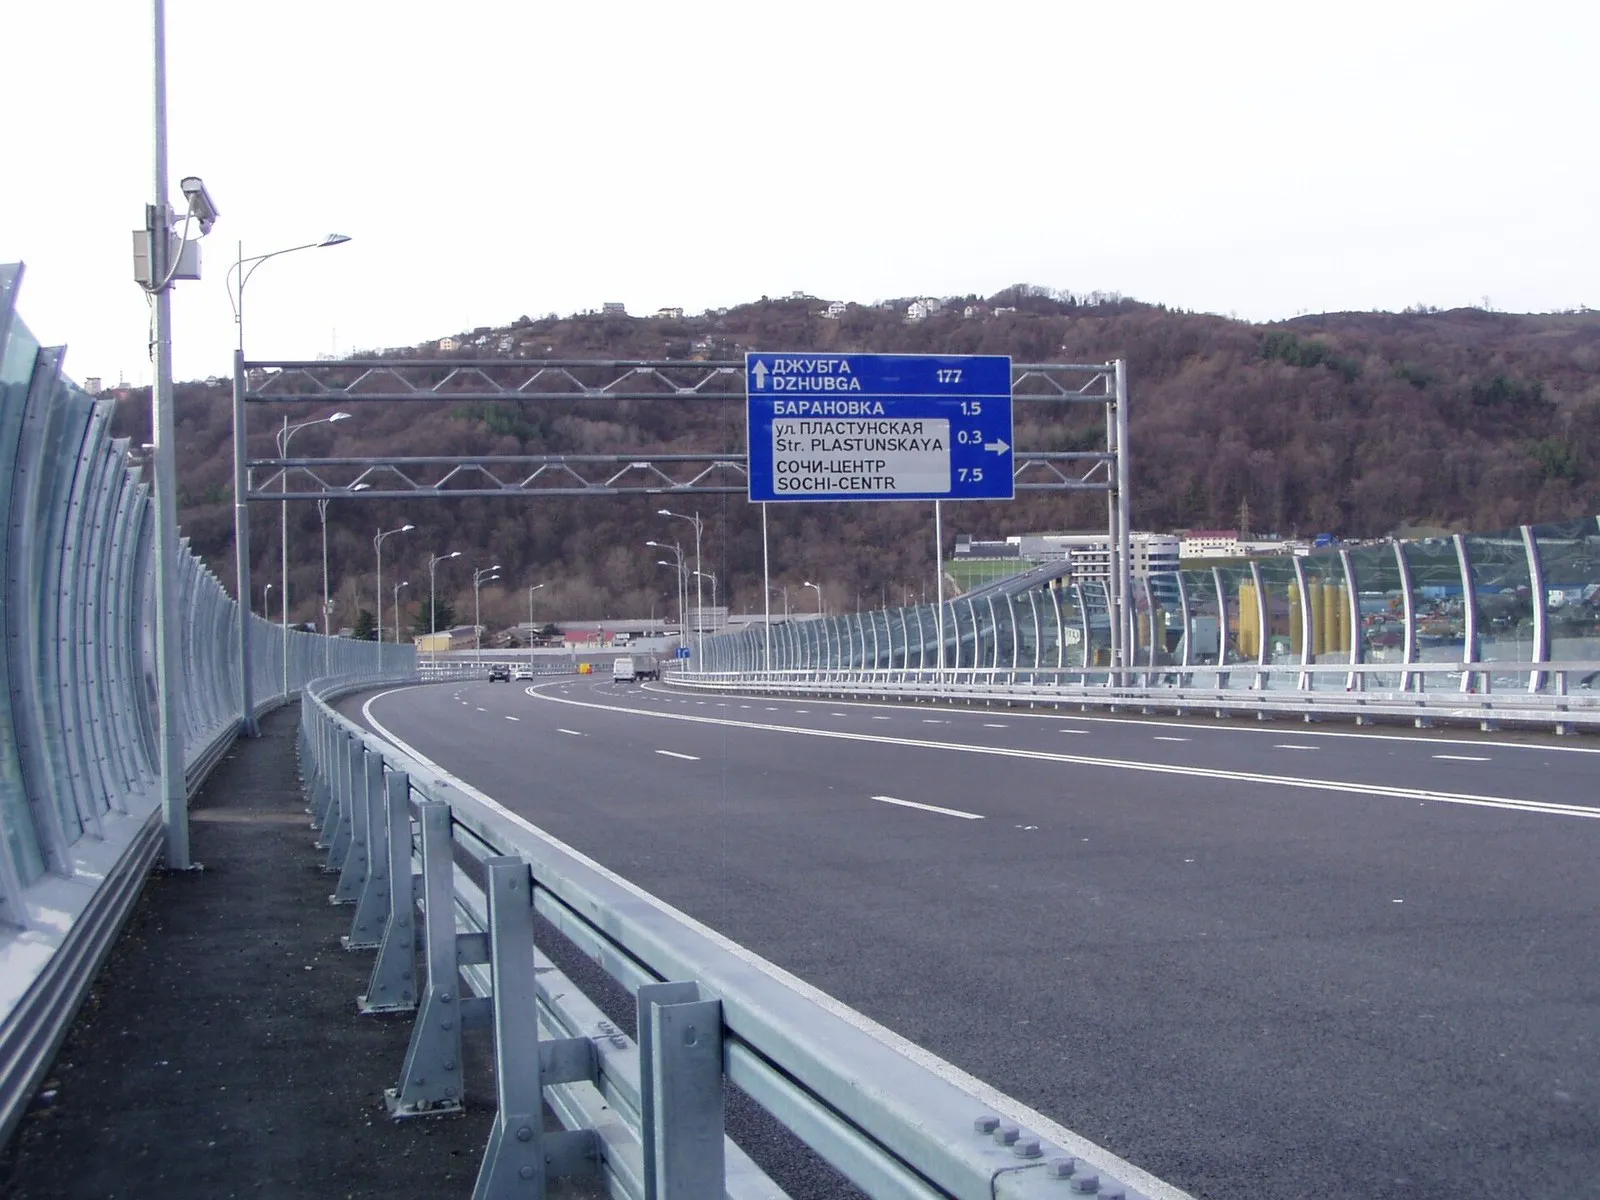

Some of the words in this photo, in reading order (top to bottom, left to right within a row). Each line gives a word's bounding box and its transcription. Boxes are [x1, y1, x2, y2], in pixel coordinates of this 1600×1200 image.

[772, 359, 850, 374] ДЖУБГА
[773, 376, 861, 390] DZHUBGA
[937, 369, 962, 383] 177
[774, 401, 885, 415] БАРАНОВКА
[800, 422, 923, 436] ПЛАСТУНСКАЯ
[776, 439, 804, 452] Str.
[811, 438, 943, 452] PLASTUNSKAYA
[776, 460, 886, 474] СОЧИ-ЦЕНТР
[778, 476, 896, 490] SOCHI-CENTR
